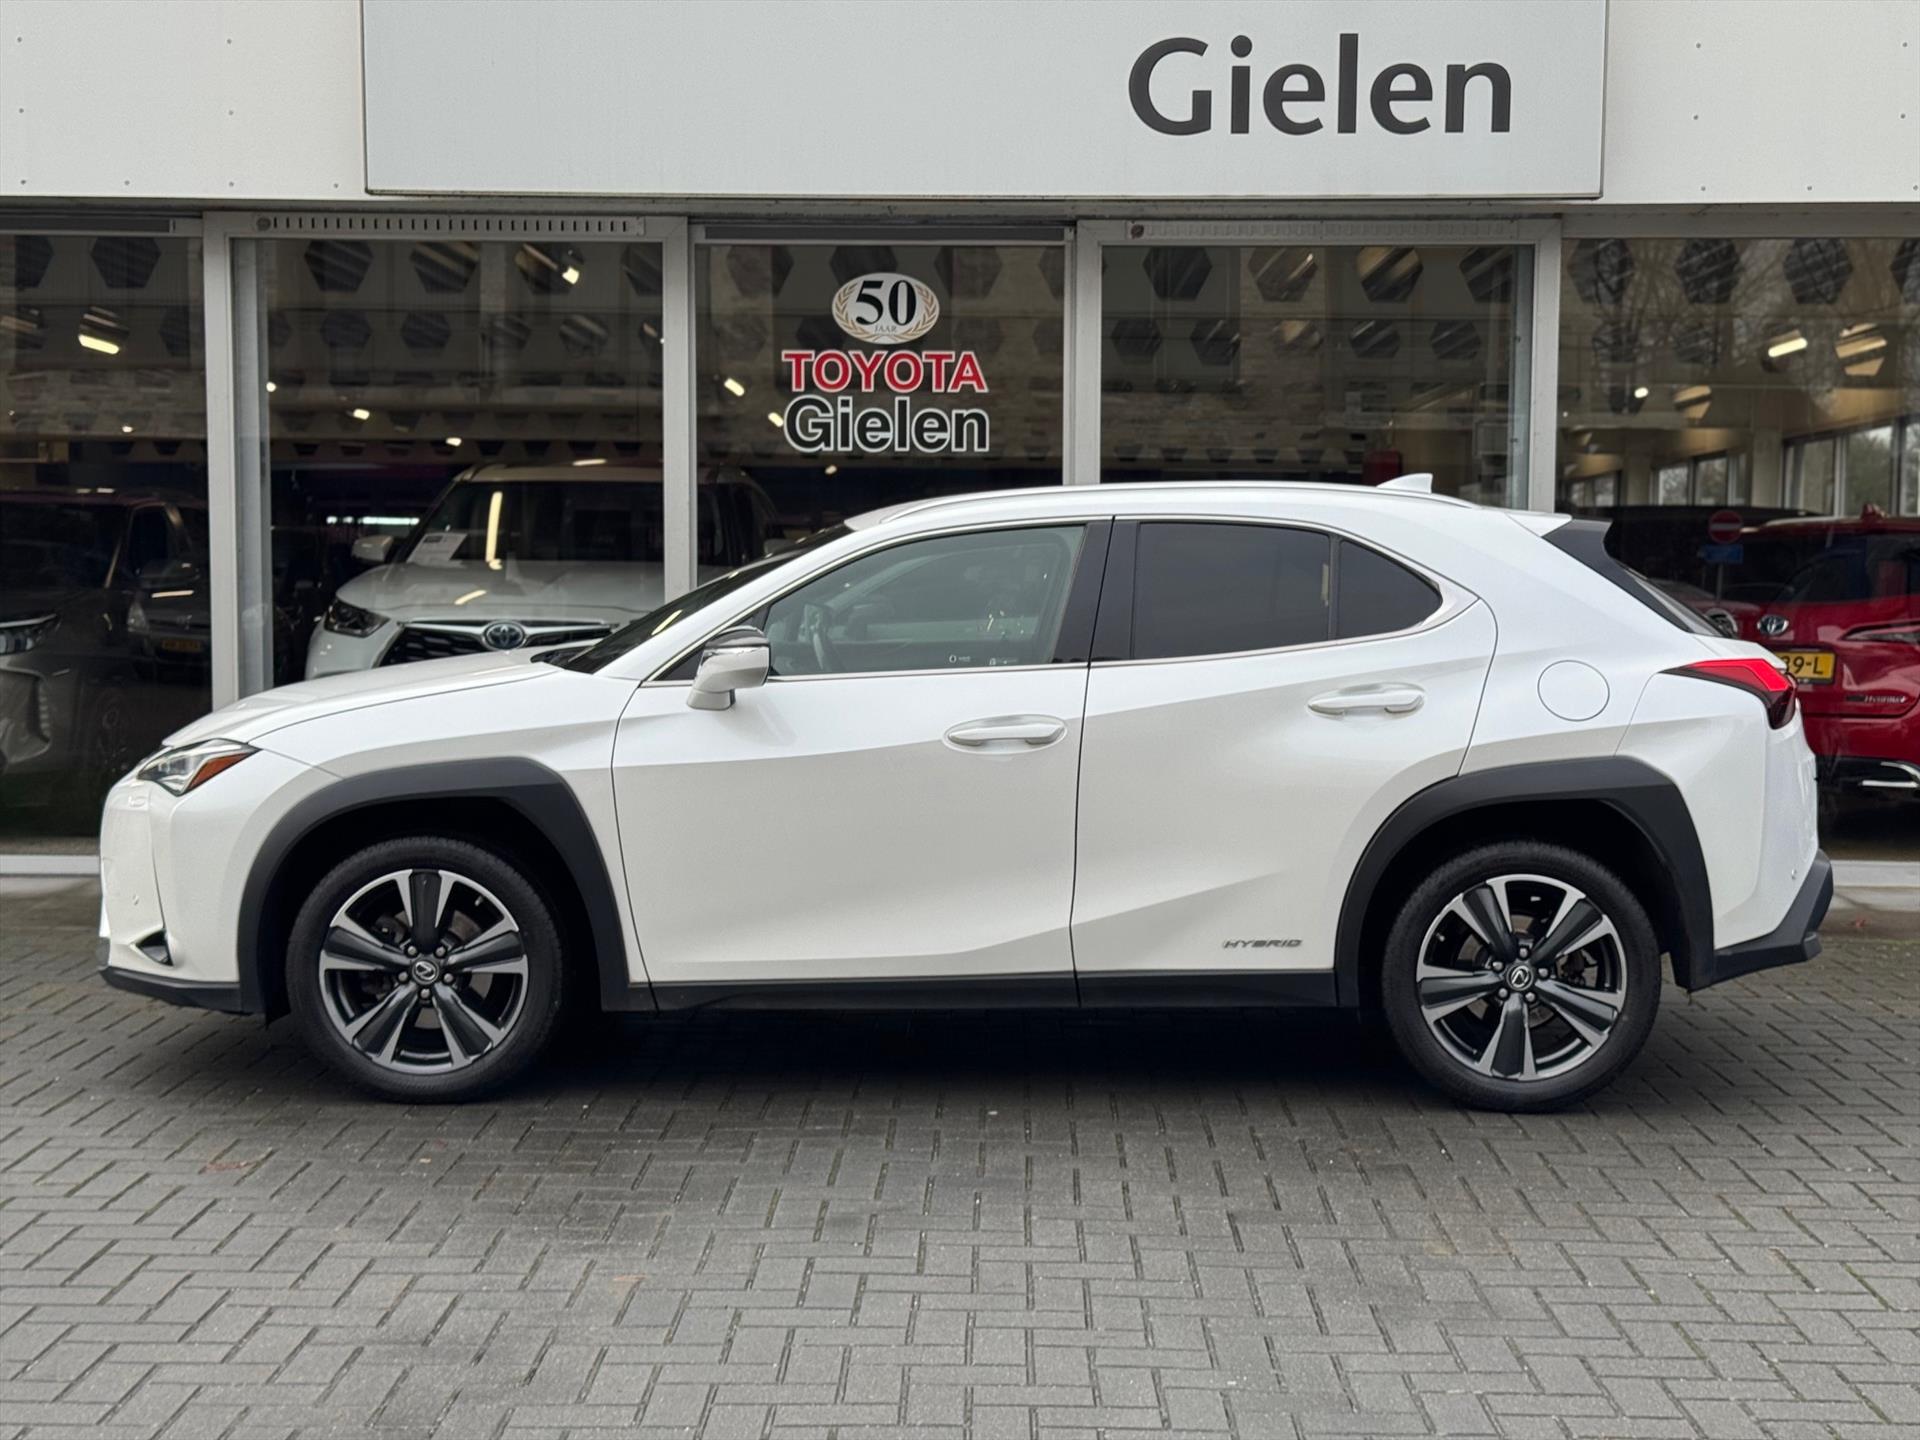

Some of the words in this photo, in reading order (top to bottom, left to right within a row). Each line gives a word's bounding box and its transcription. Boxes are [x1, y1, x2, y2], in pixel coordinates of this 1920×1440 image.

[1128, 33, 1511, 136] Gielen
[855, 280, 917, 326] 50
[874, 325, 897, 333] JAAR
[782, 350, 989, 393] TOYOTA
[784, 395, 990, 453] Gielen
[1224, 939, 1302, 949] HYBRID
